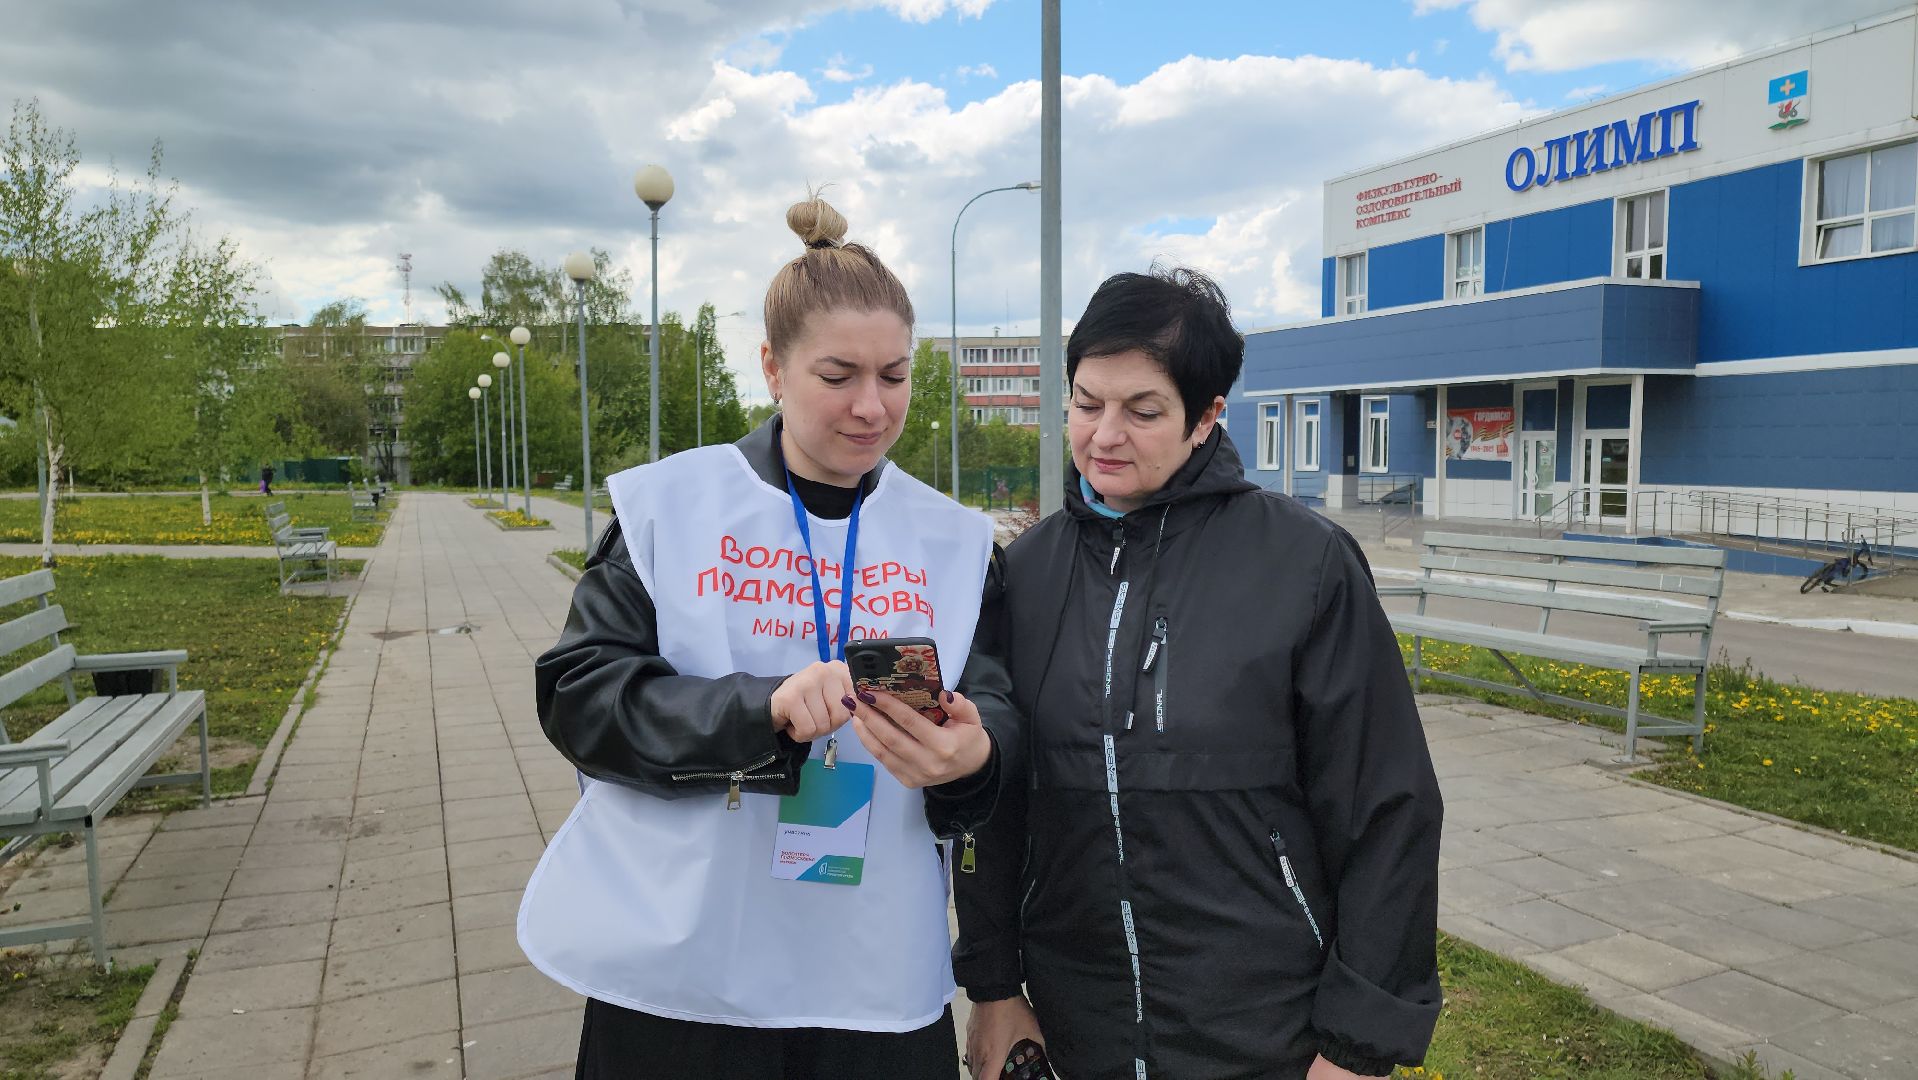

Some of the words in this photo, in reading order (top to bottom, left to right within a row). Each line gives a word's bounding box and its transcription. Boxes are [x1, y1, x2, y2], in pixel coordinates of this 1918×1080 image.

[1505, 99, 1702, 193] ОЛИМП
[1355, 177, 1462, 215] ОЗДОРОВИТЕЛЬНЫЙ
[1356, 172, 1443, 201] ФИЗКУЛЬТУРНО-
[1355, 208, 1411, 229] КОМПЛЕКС
[720, 535, 928, 588] ВОЛОНЕРЫ
[752, 618, 795, 639] МЫ
